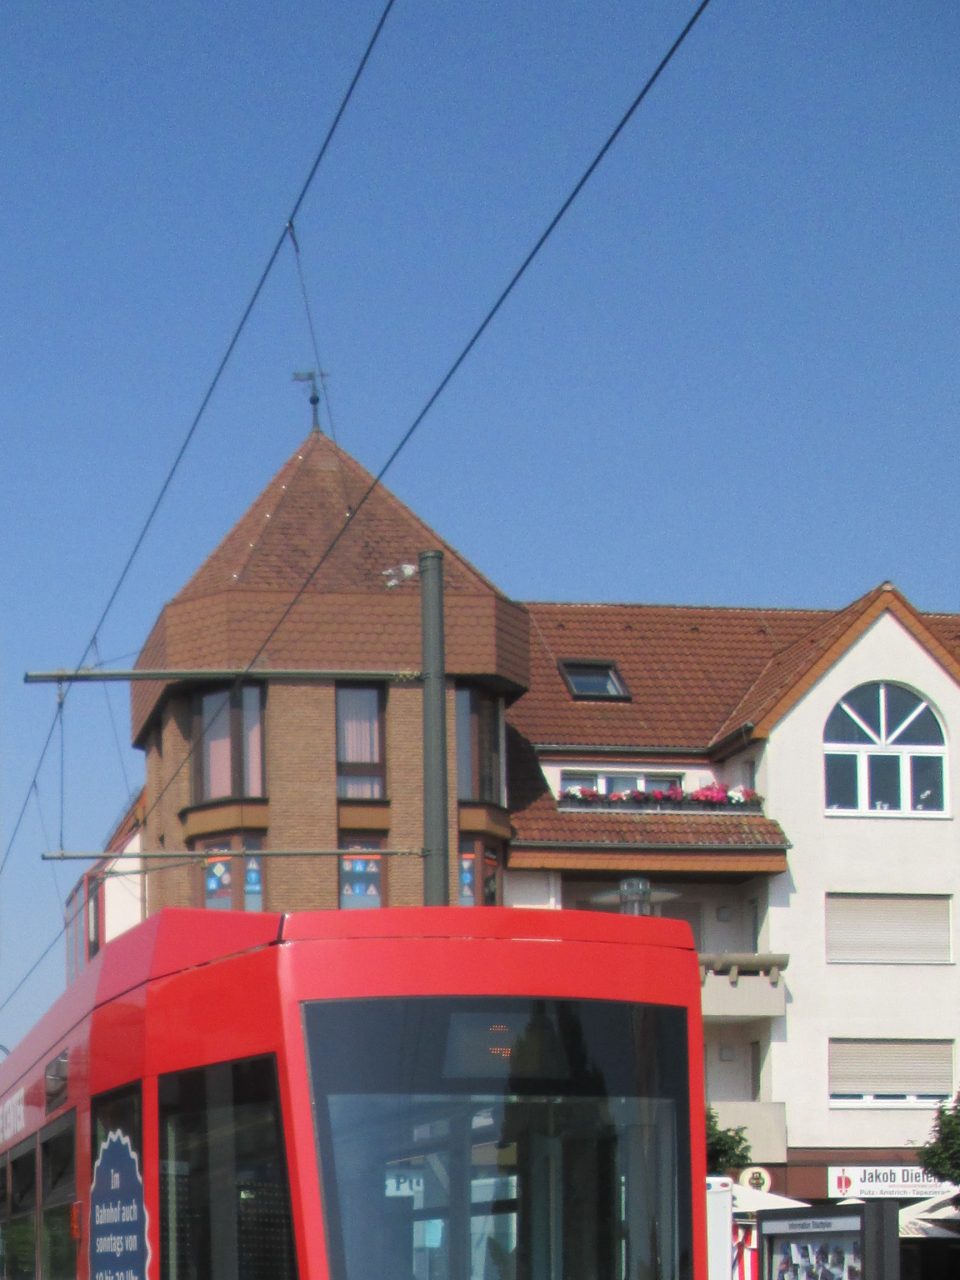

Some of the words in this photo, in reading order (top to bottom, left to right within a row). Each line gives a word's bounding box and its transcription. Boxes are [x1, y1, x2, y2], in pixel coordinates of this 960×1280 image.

[110, 1168, 121, 1190] Im
[859, 1168, 896, 1183] Jakob
[95, 1200, 121, 1226] Bahnhof
[122, 1199, 138, 1223] auch
[95, 1233, 124, 1258] sonntags
[125, 1234, 138, 1251] von
